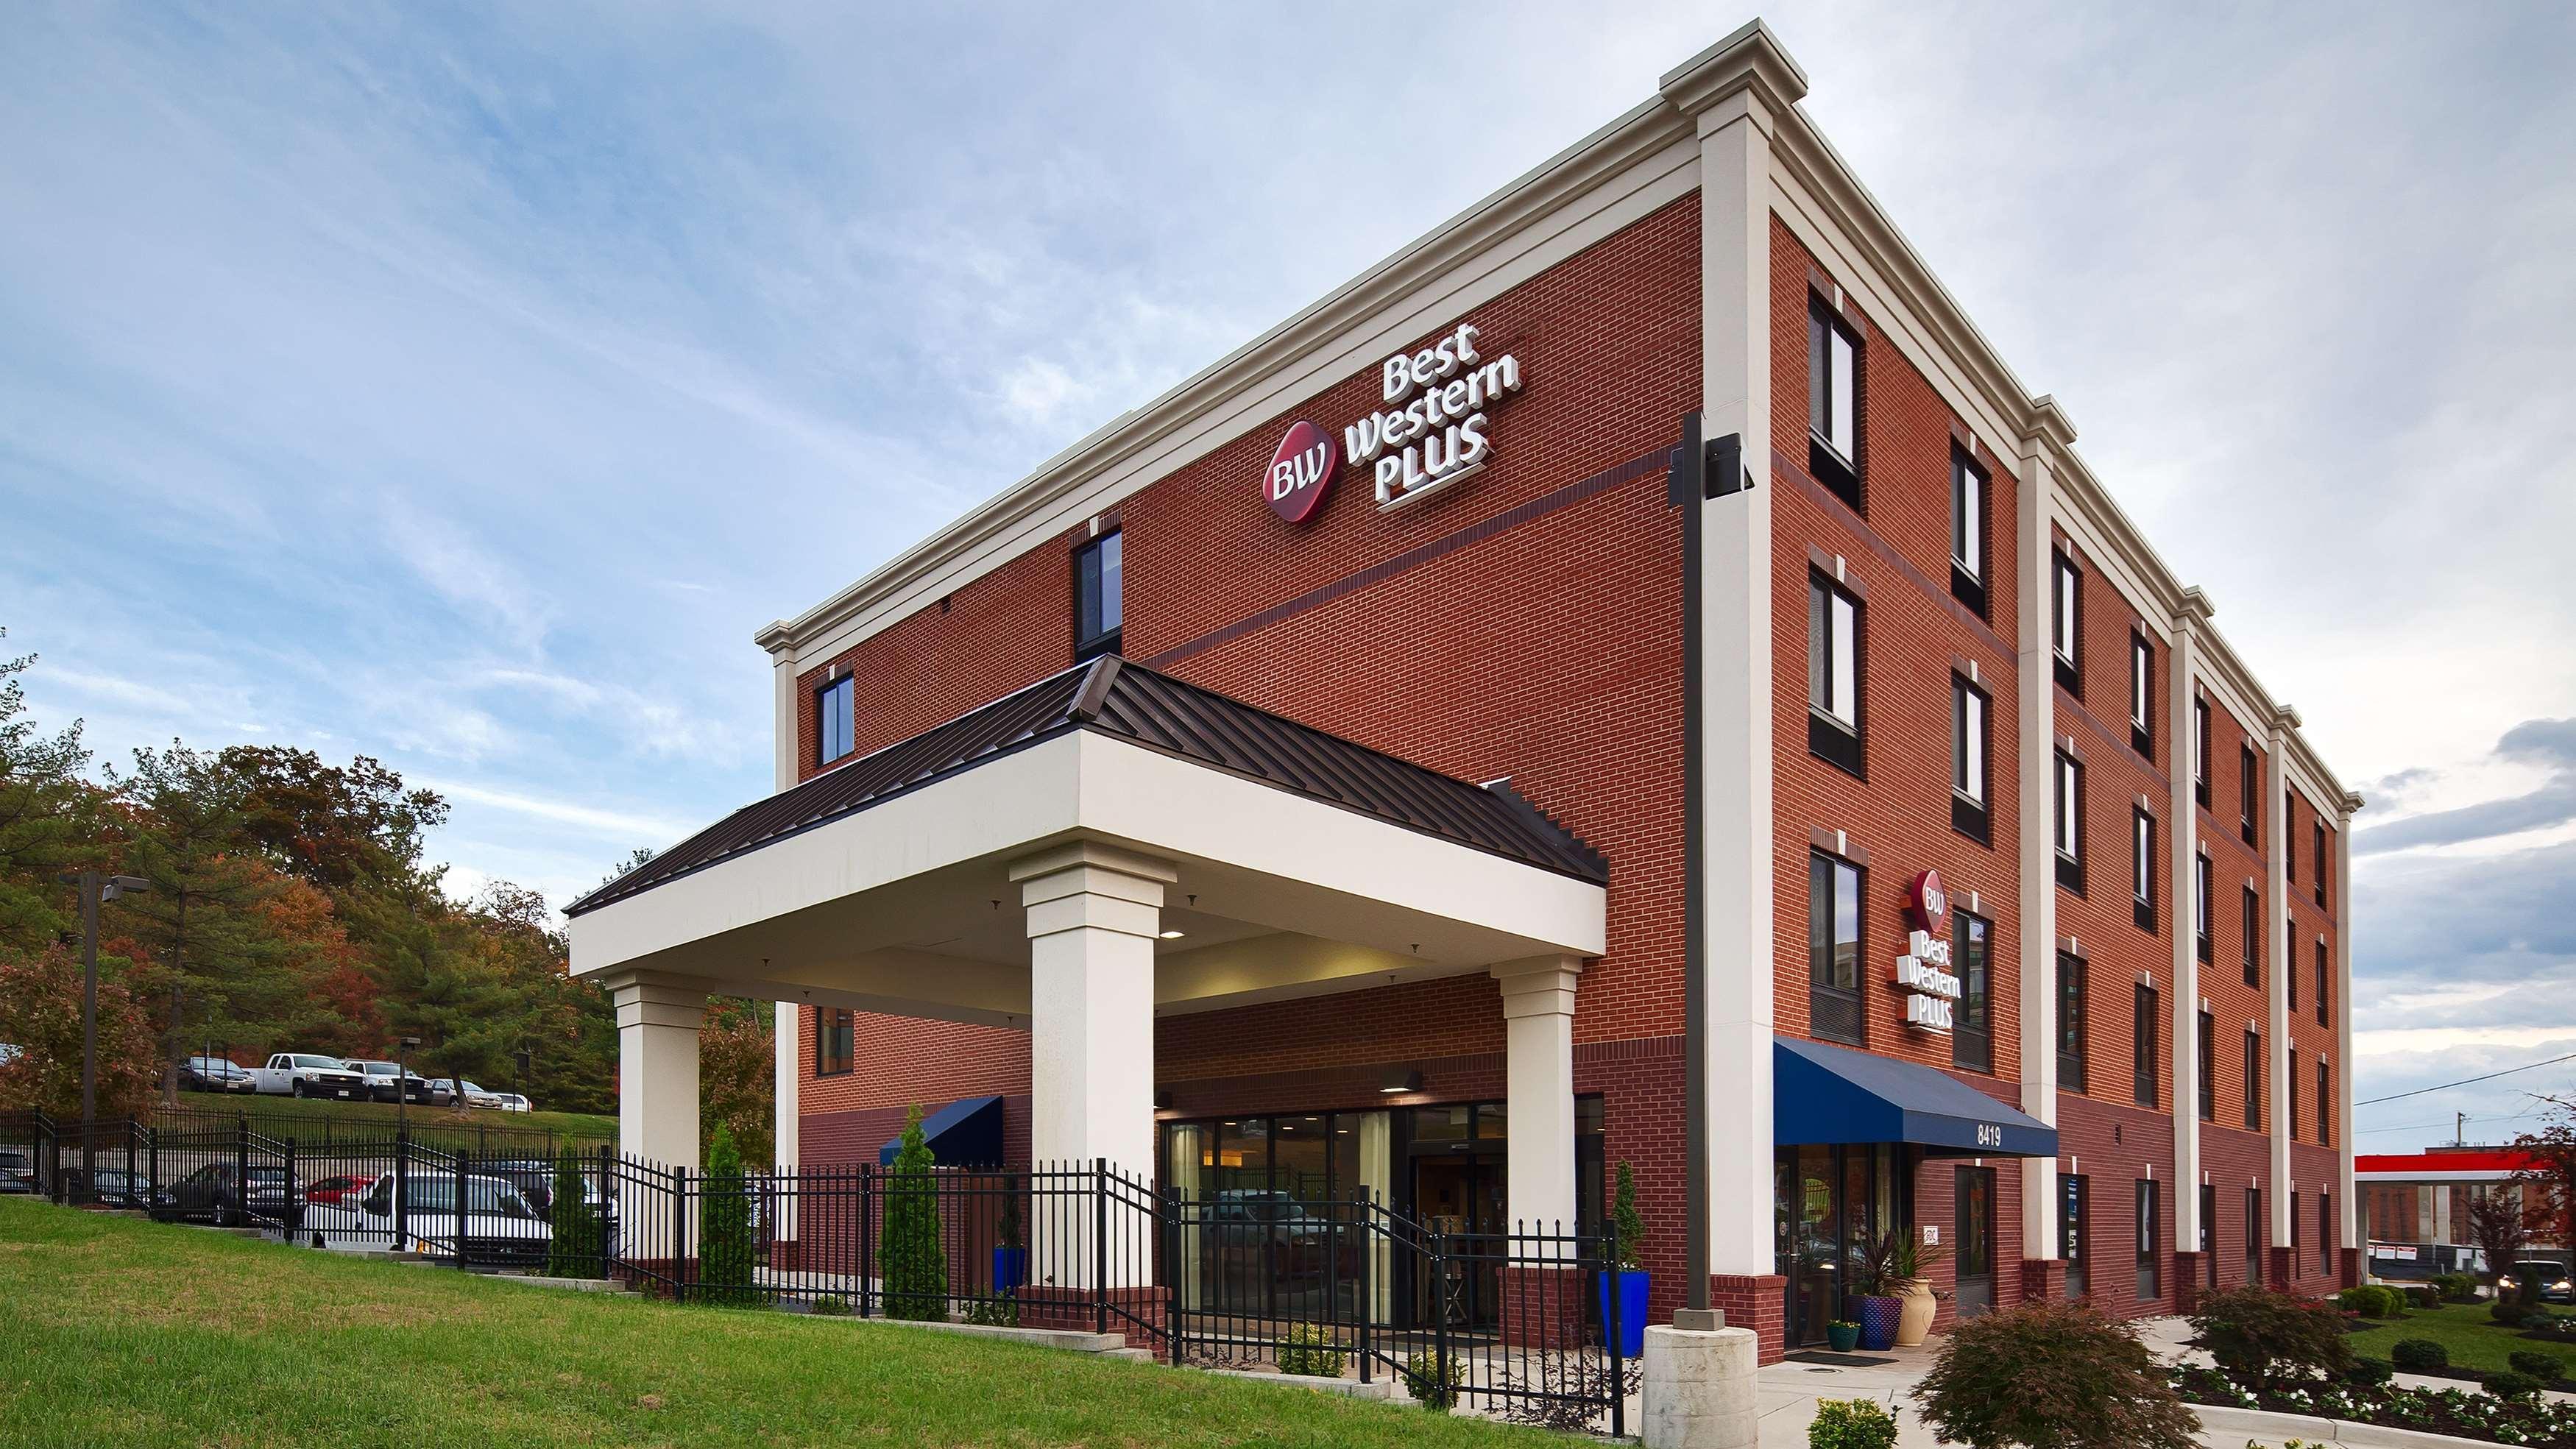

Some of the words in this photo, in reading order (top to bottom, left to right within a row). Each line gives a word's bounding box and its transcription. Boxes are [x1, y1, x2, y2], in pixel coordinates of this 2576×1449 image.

[1383, 322, 1480, 404] Best
[1344, 354, 1522, 467] Western
[1272, 442, 1326, 501] BW
[1375, 412, 1489, 504] PLUS
[1924, 886, 1945, 916] BW
[1917, 930, 1950, 966] Best
[1905, 954, 1961, 999] Western
[1915, 995, 1953, 1029] PLUS
[1978, 1124, 2001, 1147] 8419
